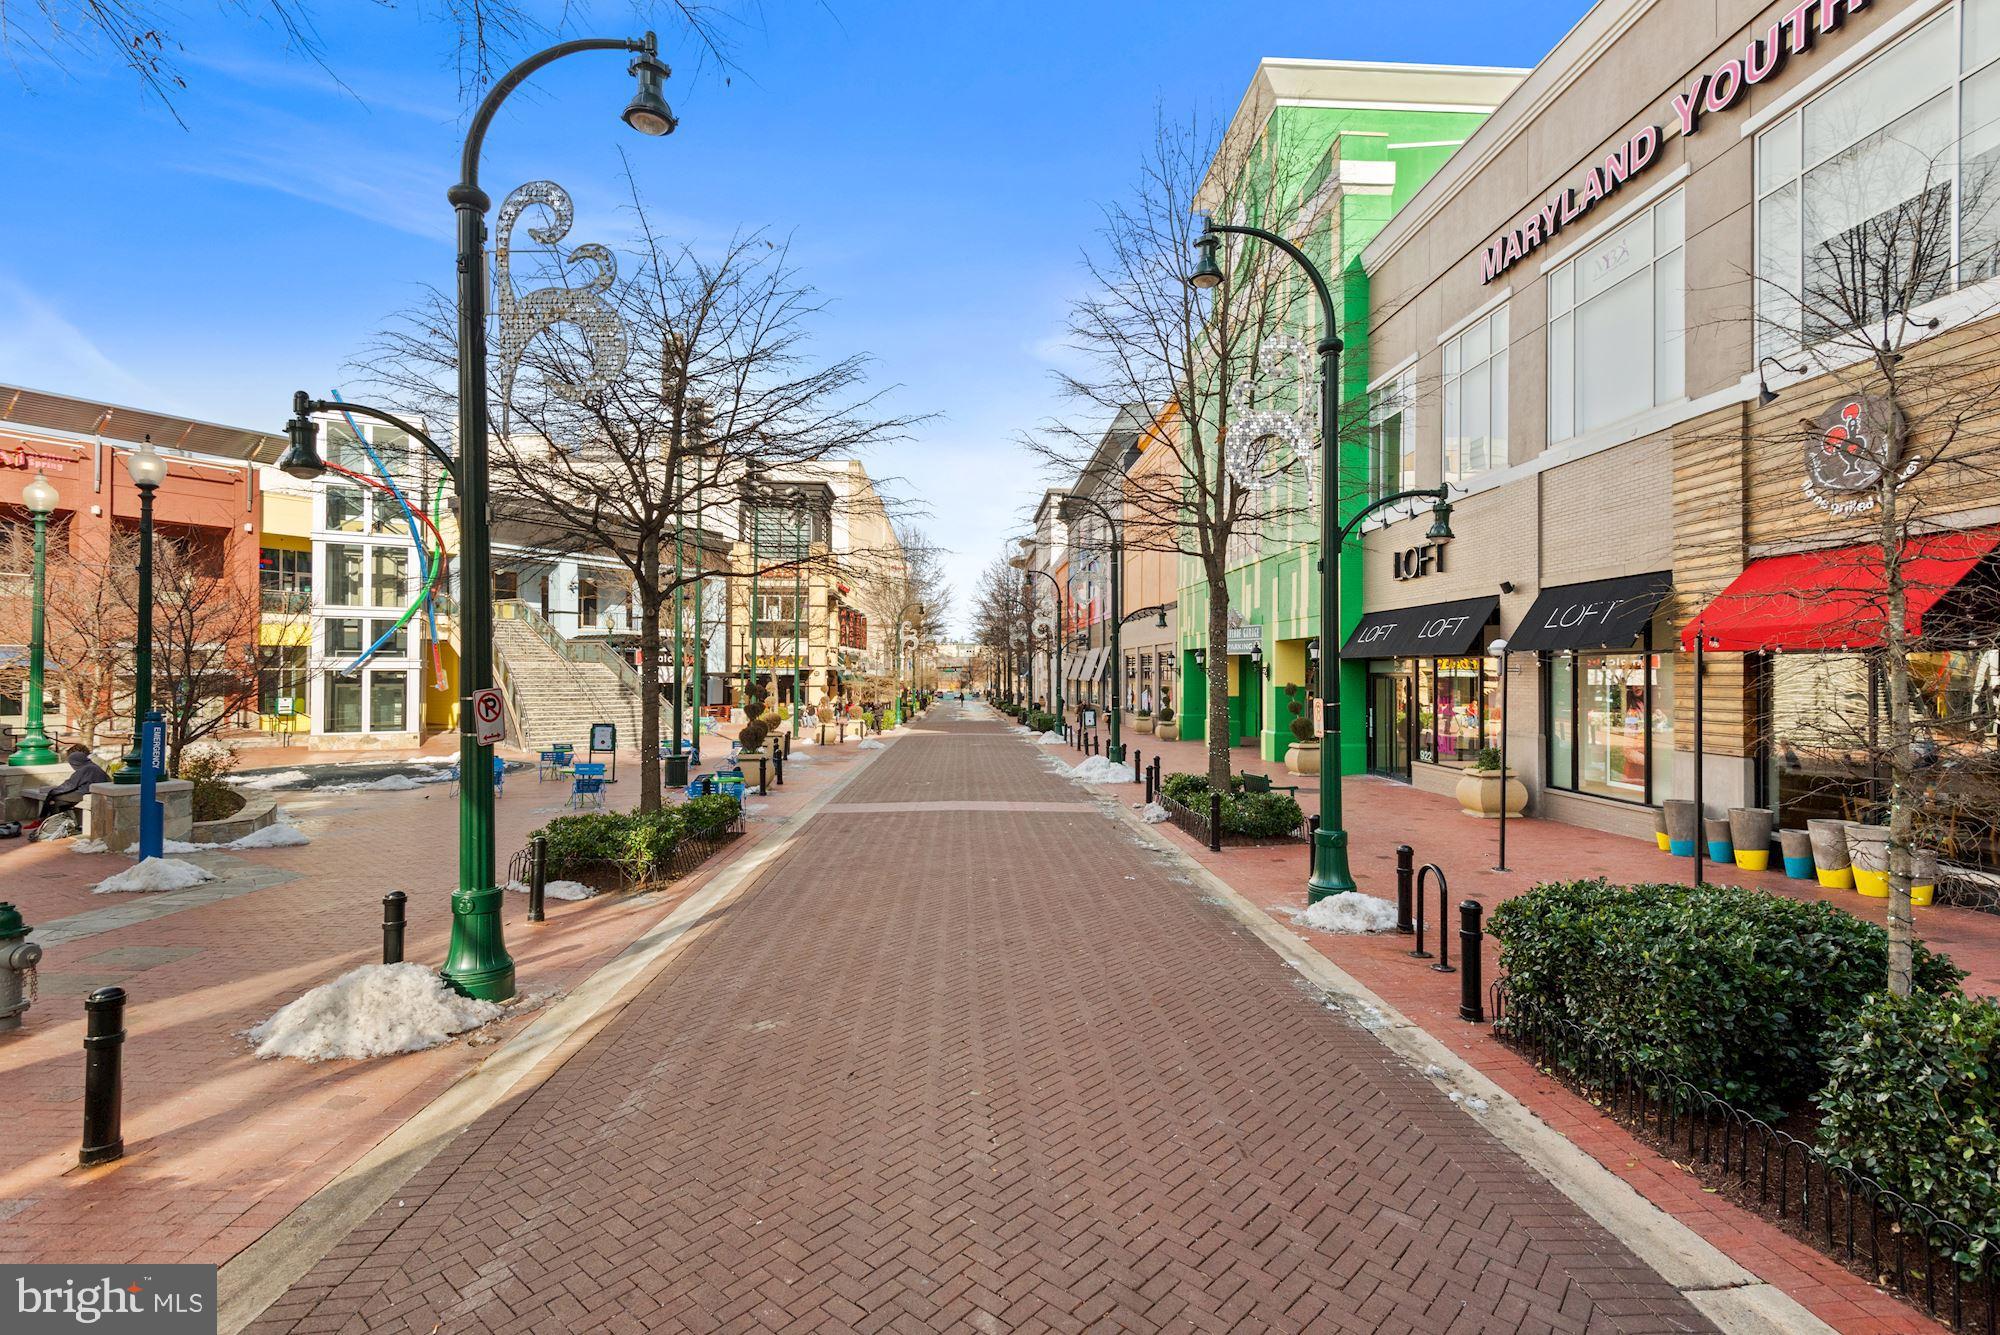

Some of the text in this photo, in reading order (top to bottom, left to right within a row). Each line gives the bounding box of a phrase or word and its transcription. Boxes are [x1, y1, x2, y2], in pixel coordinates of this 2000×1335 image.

[1480, 125, 1663, 286] MARYLAND
[1393, 543, 1446, 581] LOFT
[1418, 616, 1470, 638] LOFT
[1544, 599, 1625, 629] LOFT
[1357, 623, 1398, 643] LOFT
[152, 726, 161, 769] EMERGENCY
[1420, 750, 1432, 761] 922
